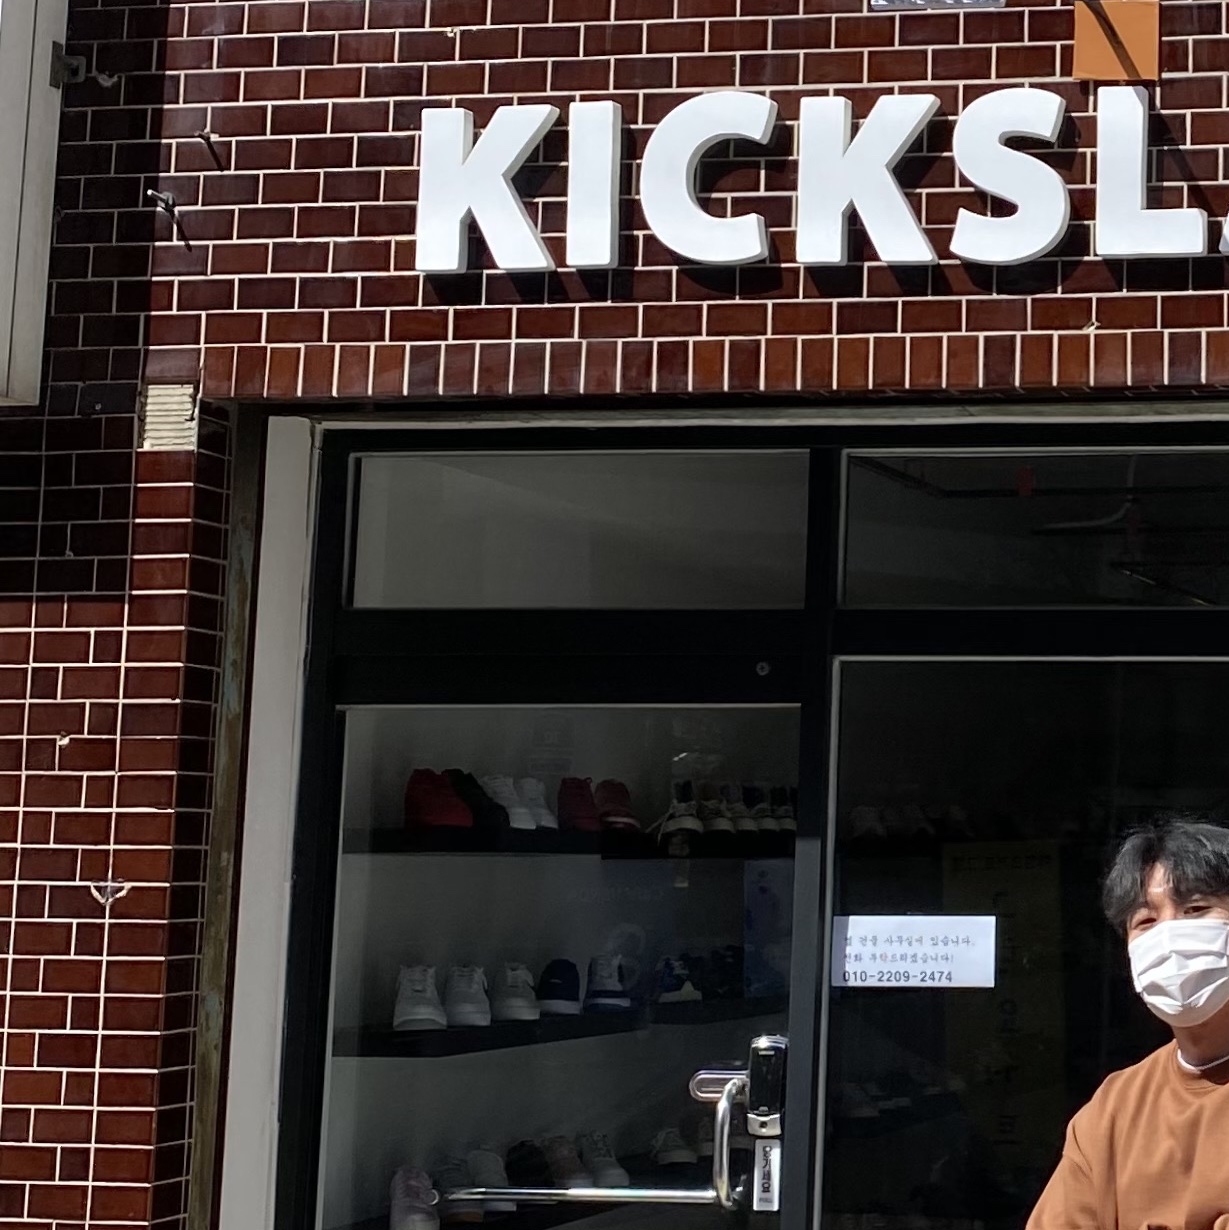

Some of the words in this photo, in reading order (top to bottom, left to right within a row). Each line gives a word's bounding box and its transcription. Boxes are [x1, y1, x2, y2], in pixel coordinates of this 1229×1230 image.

[859, 935, 879, 947] 건물
[883, 935, 924, 947] 사무실에
[843, 970, 953, 983] 010-2209-2474
